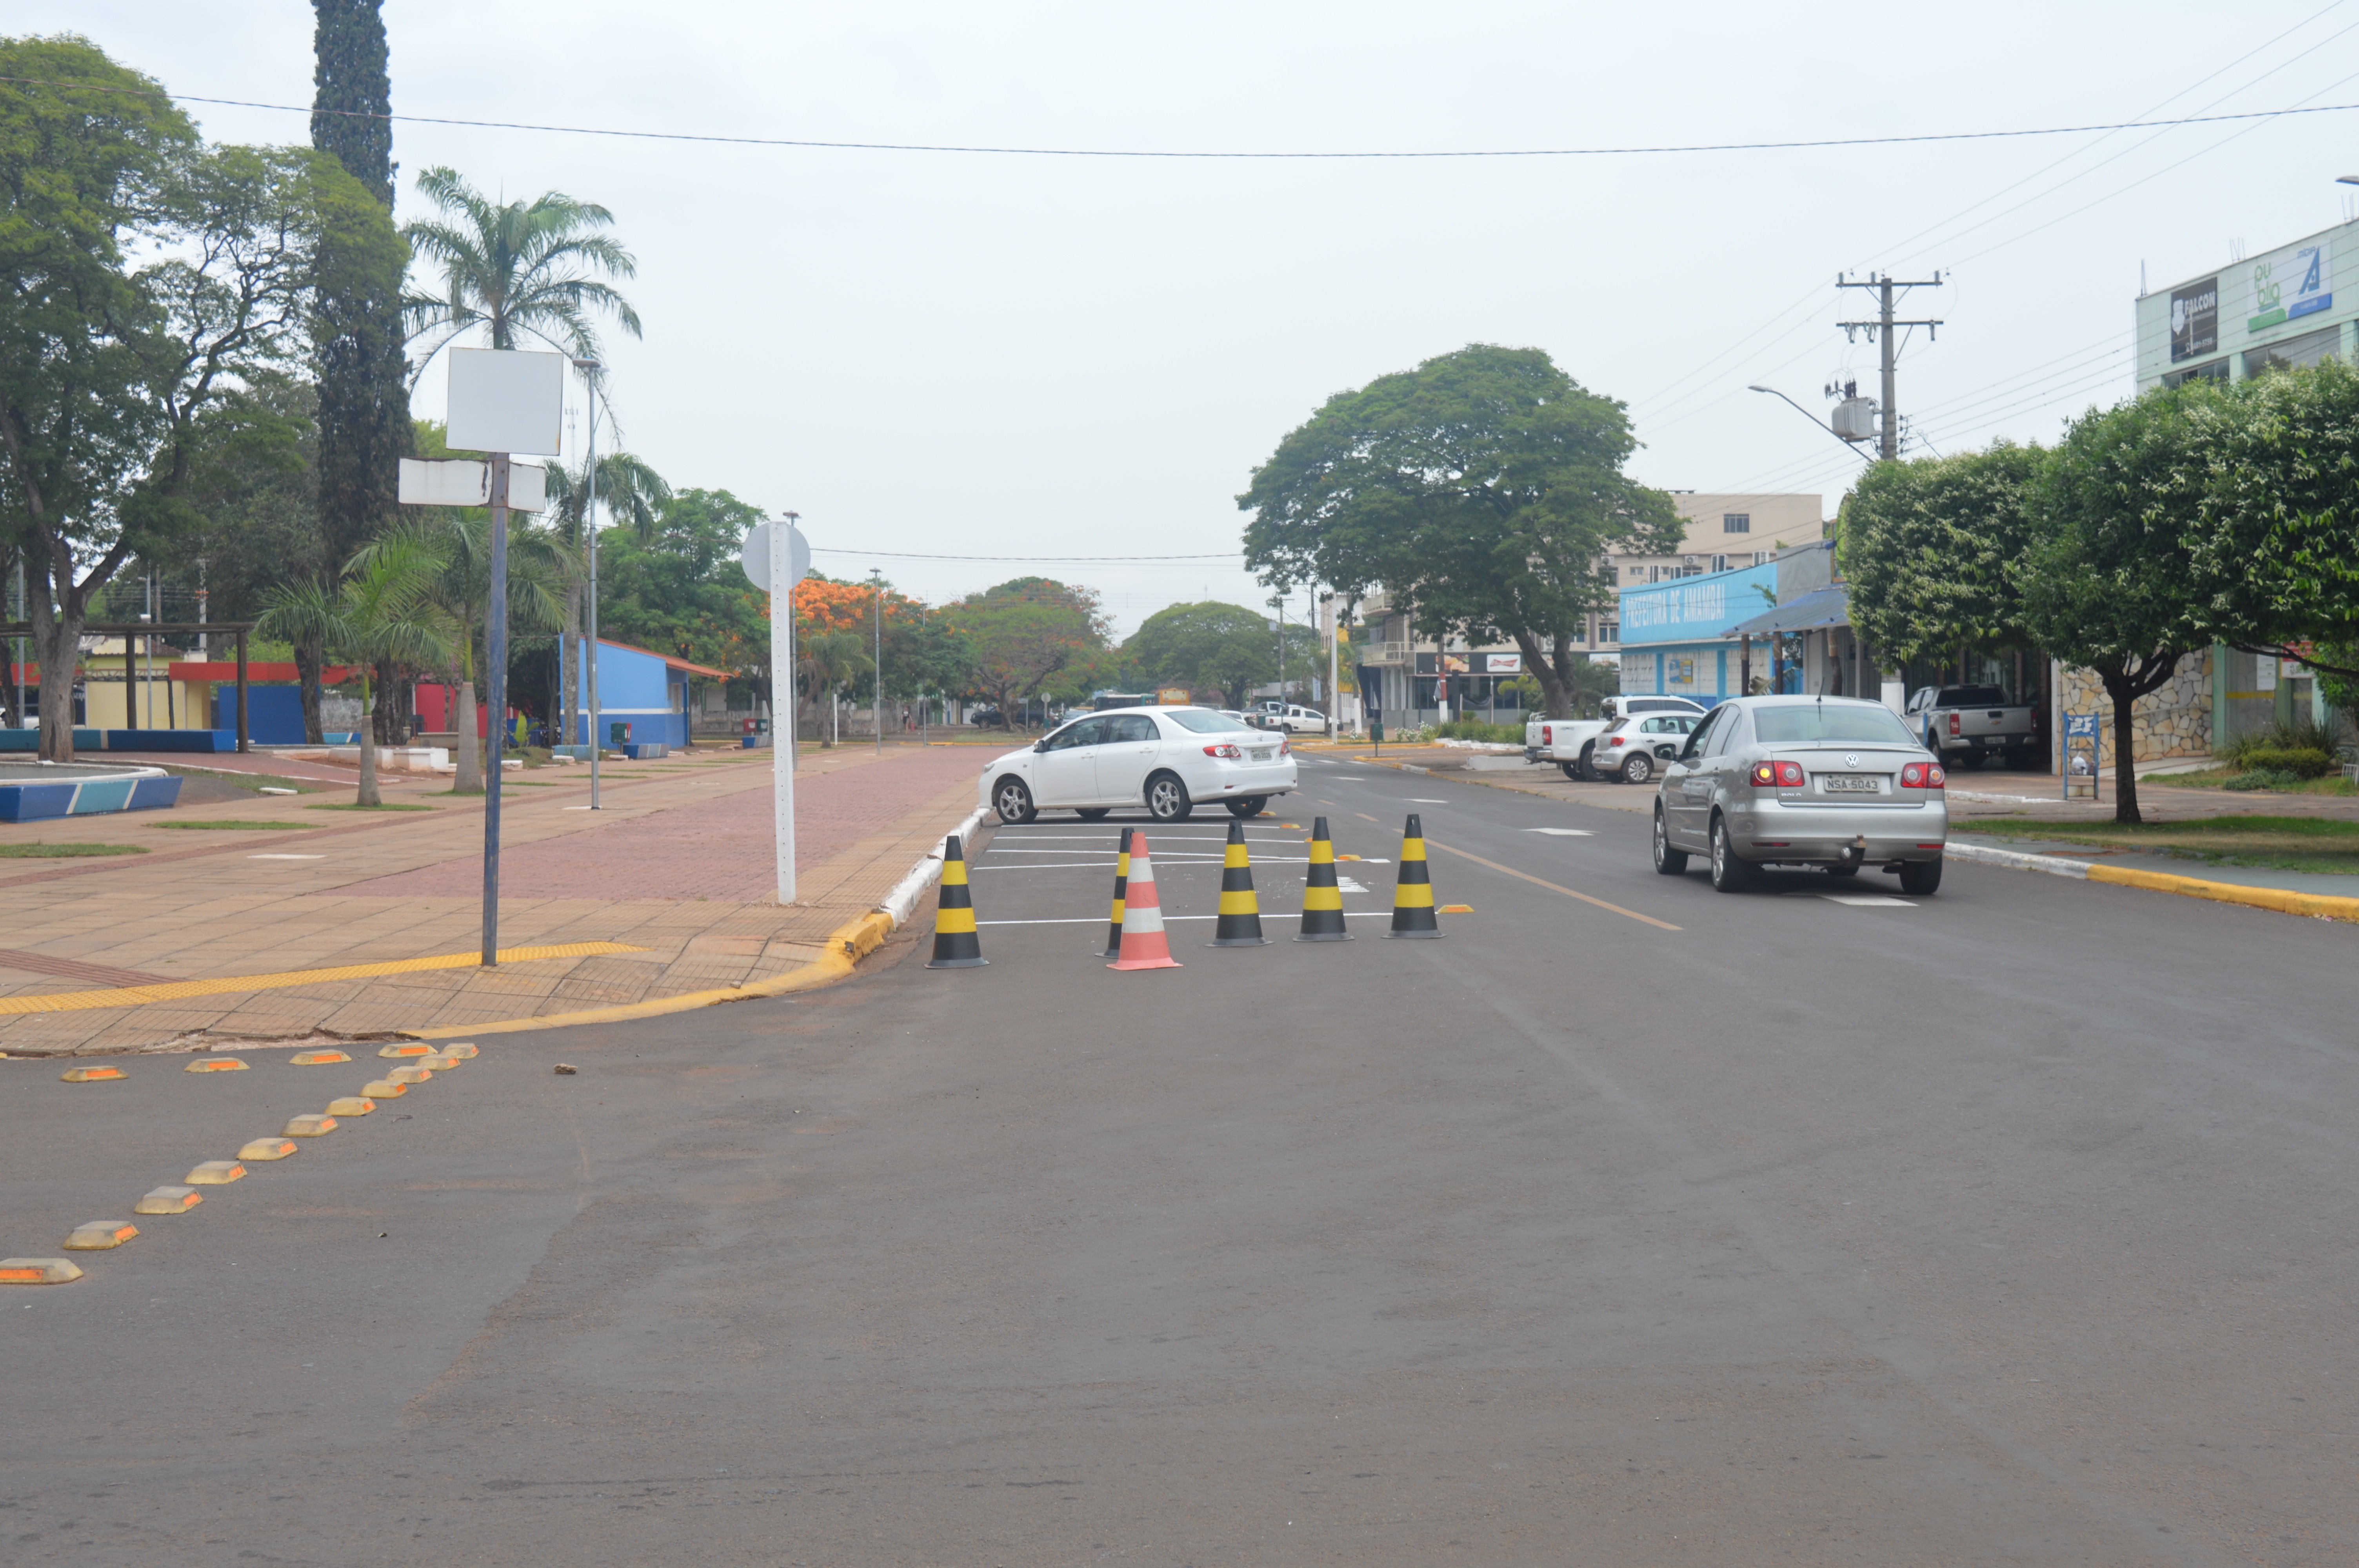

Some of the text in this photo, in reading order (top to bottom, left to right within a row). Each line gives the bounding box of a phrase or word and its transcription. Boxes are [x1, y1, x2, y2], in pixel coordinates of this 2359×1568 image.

[2184, 290, 2216, 316] FALCON
[1625, 583, 1725, 629] PREFEITURA DE AMAMBAI
